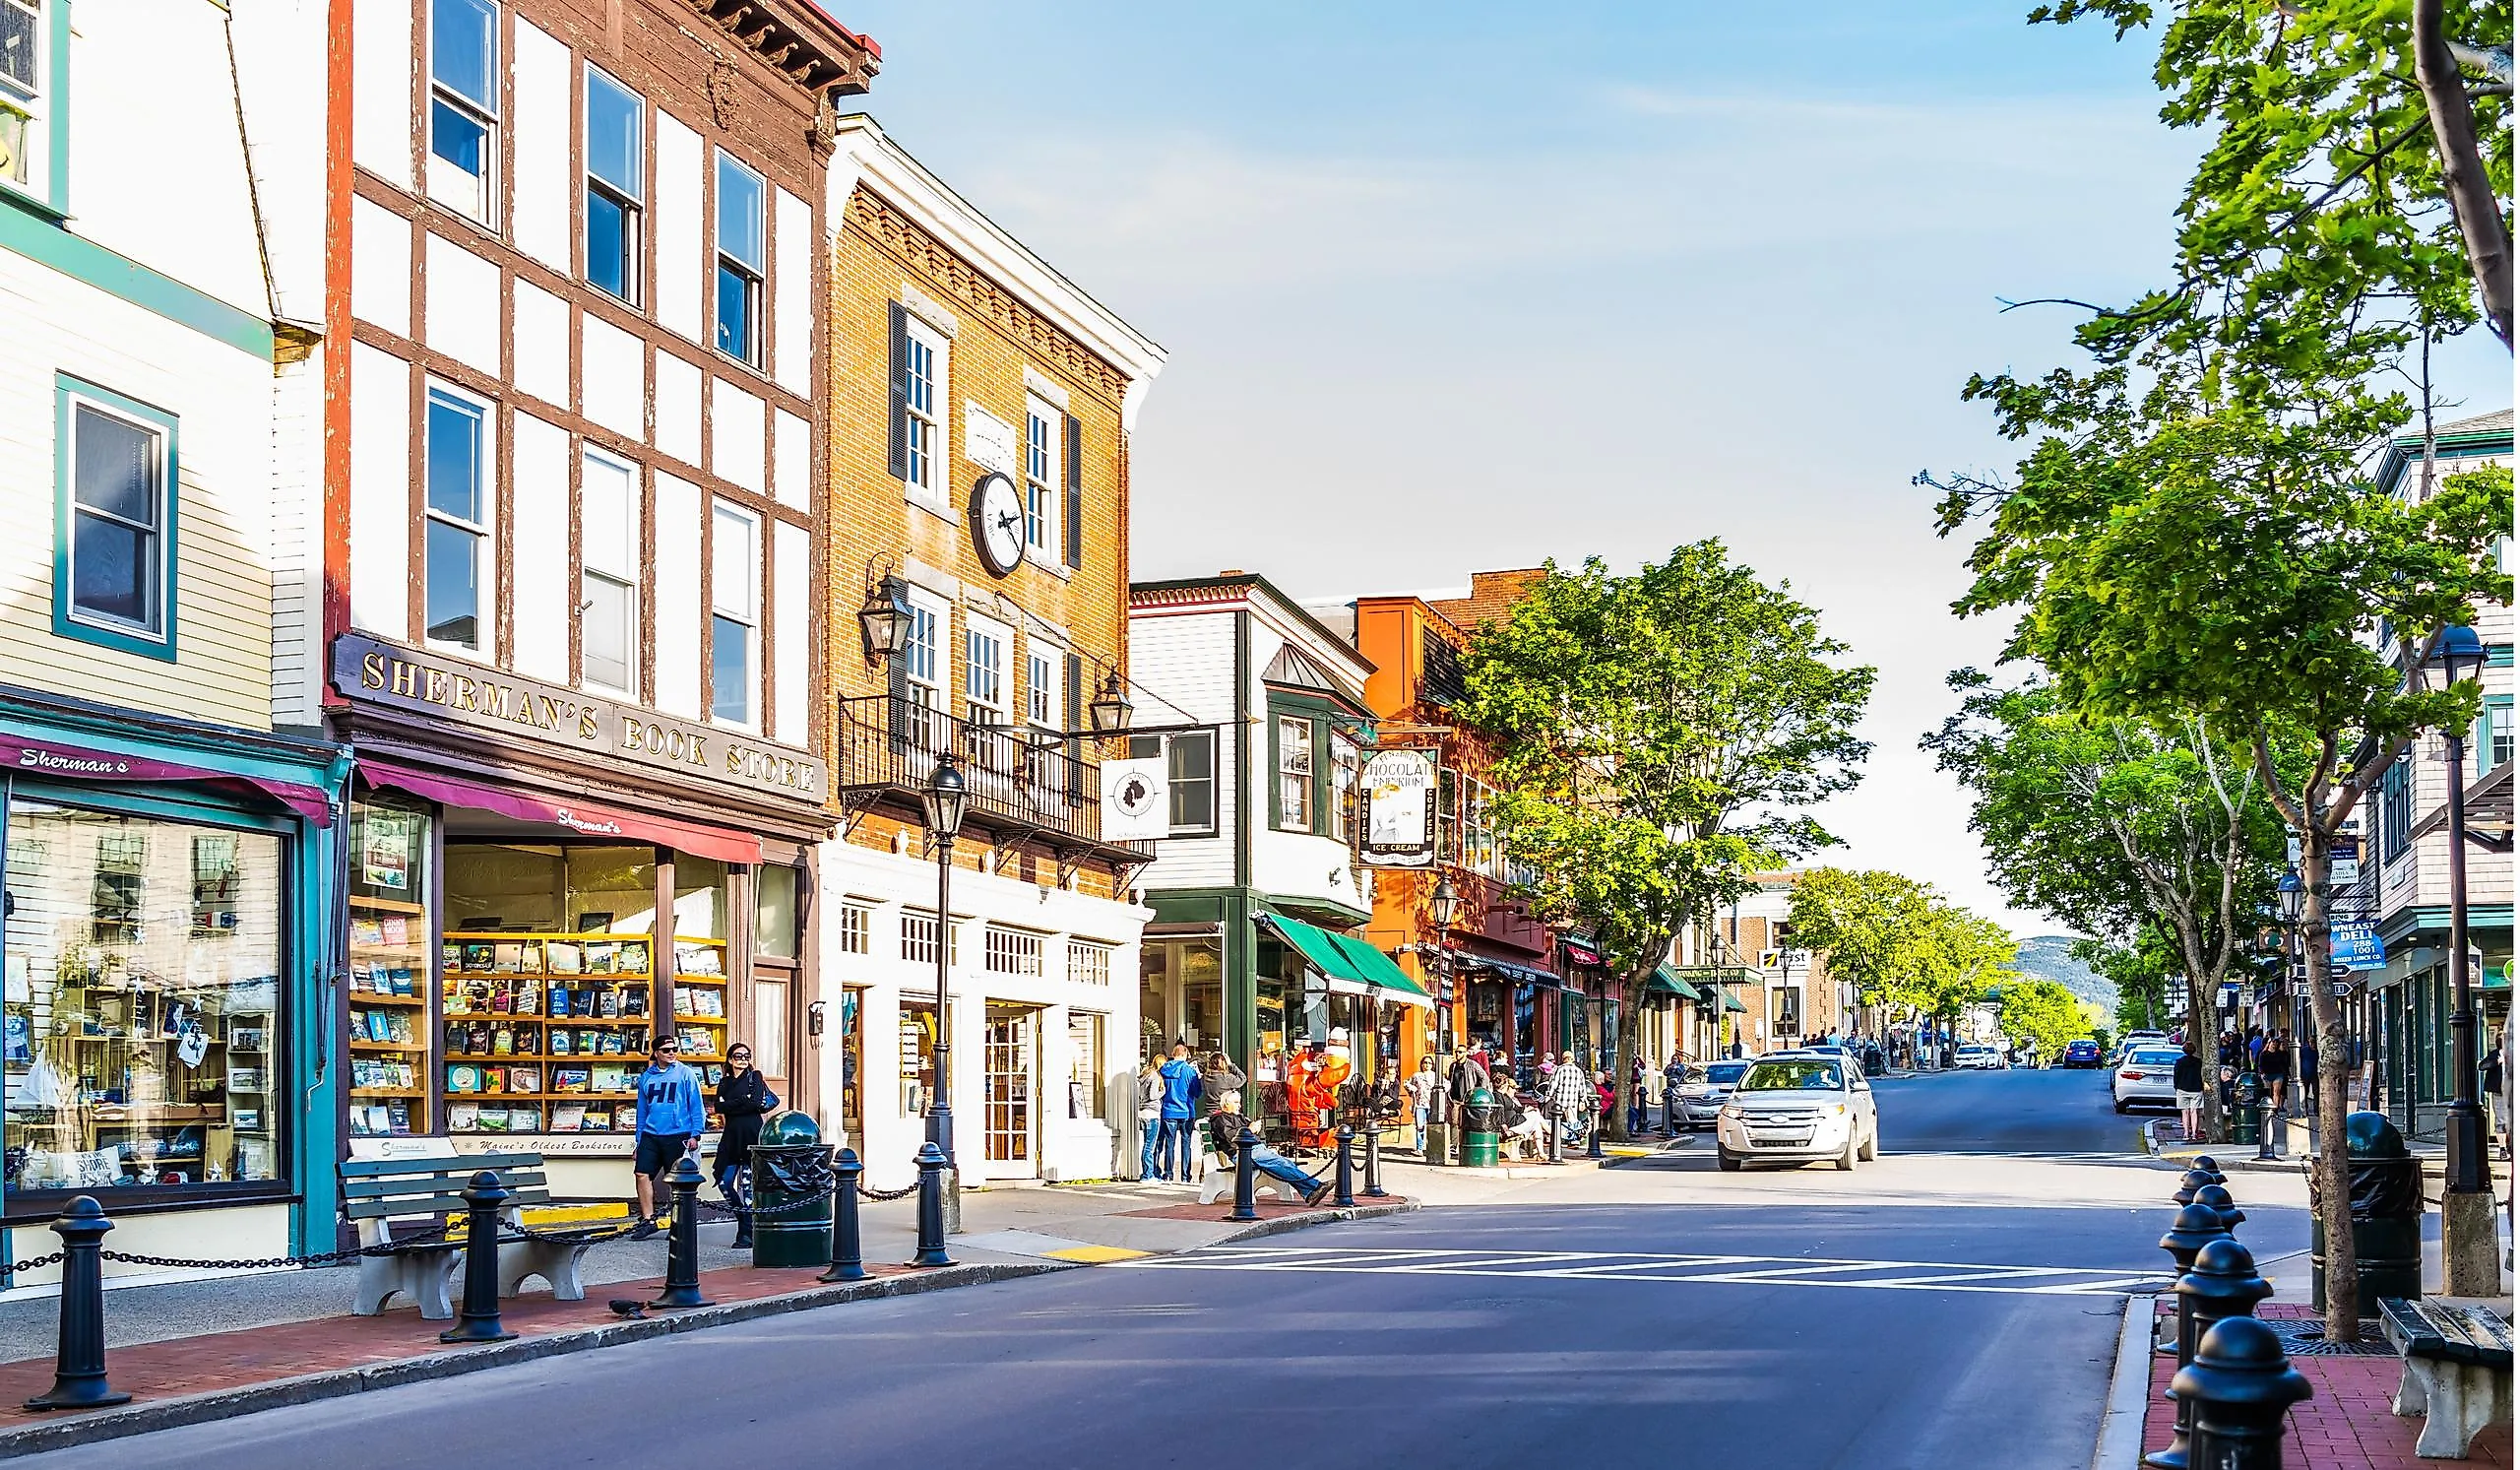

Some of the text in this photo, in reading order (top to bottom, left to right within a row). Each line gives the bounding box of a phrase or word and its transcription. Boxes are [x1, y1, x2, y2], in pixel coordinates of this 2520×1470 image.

[361, 652, 815, 793] SHERMAN'S BOOK STORE
[20, 749, 130, 773] Shermans
[557, 808, 623, 834] Sherman's
[2331, 922, 2375, 932] WNEAST
[2340, 929, 2372, 941] DELI
[647, 1082, 678, 1104] HI
[382, 1142, 426, 1157] Sherman's
[479, 1140, 623, 1150] Maine's Oldest Bookstore
[79, 1158, 111, 1172] SHORE
